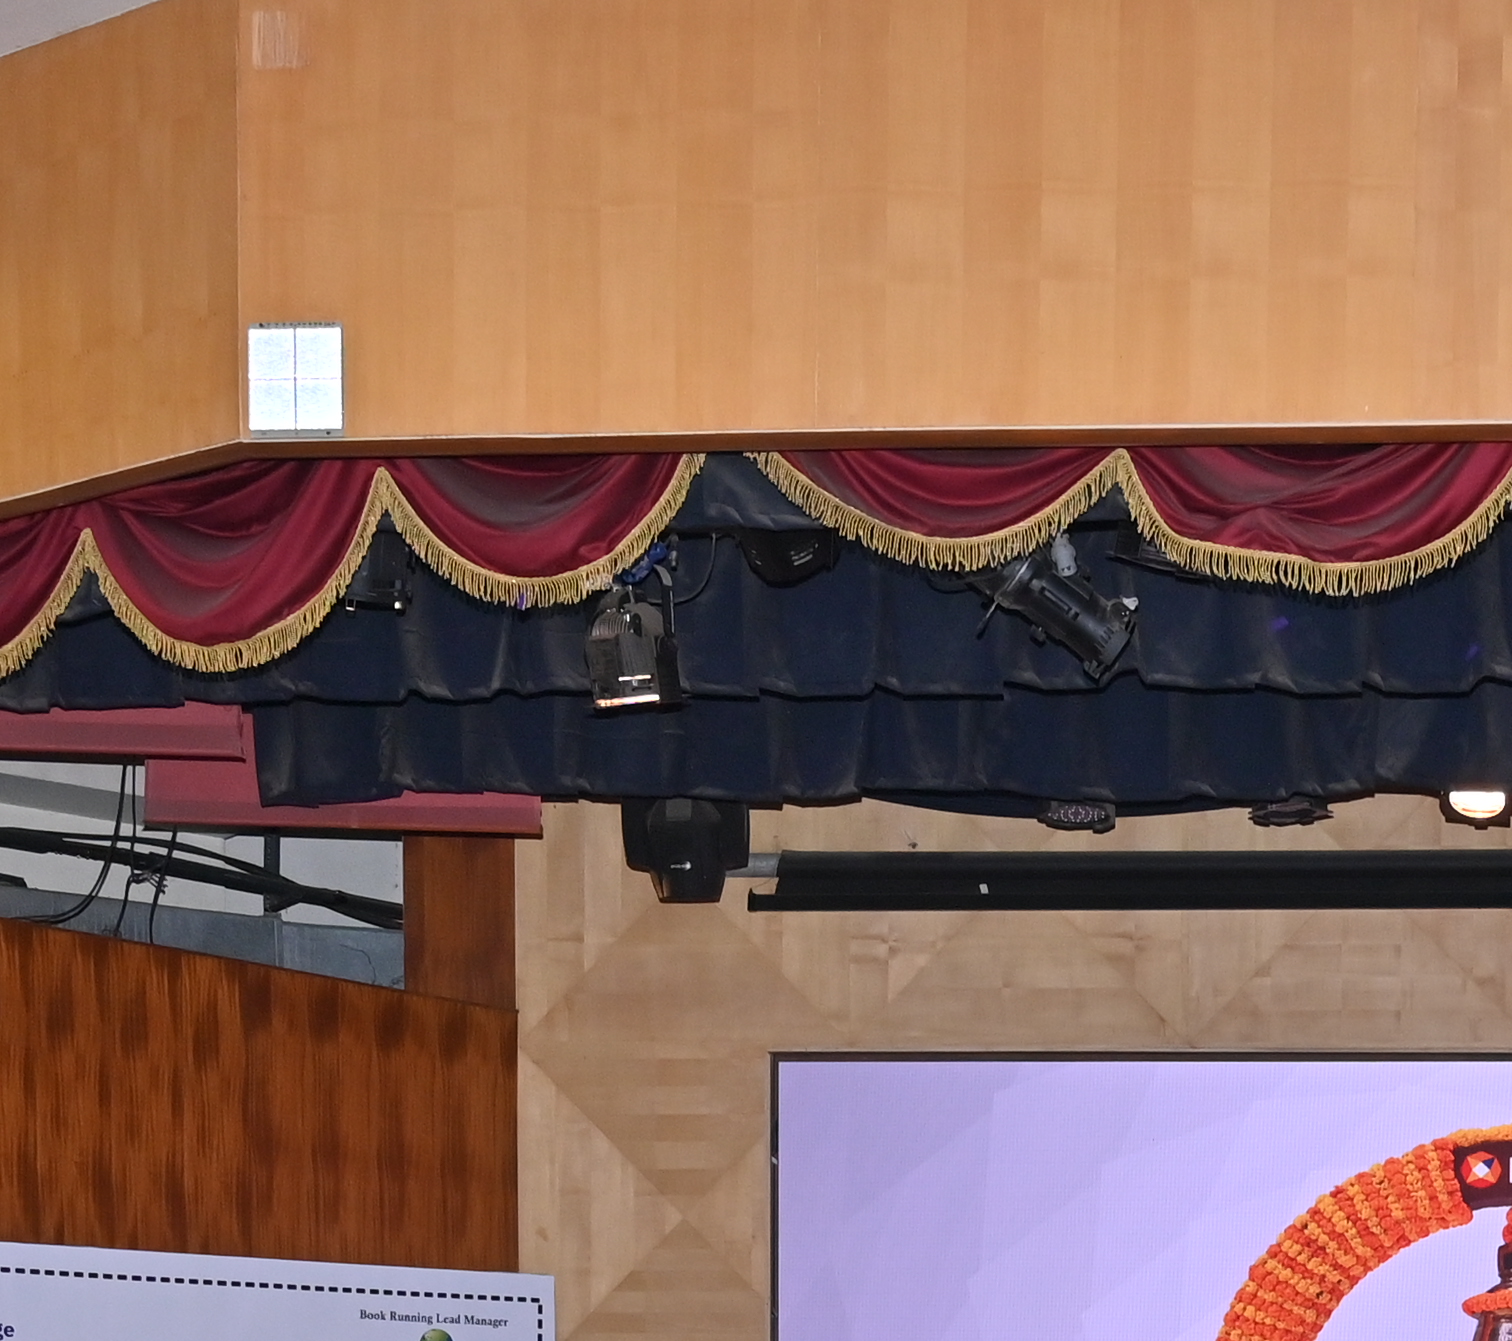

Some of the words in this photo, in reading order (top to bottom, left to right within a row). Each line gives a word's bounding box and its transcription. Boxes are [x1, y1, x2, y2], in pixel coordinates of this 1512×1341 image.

[360, 1309, 386, 1321] Book
[390, 1311, 433, 1325] Running
[436, 1313, 461, 1324] Lead
[464, 1314, 508, 1328] Manager
